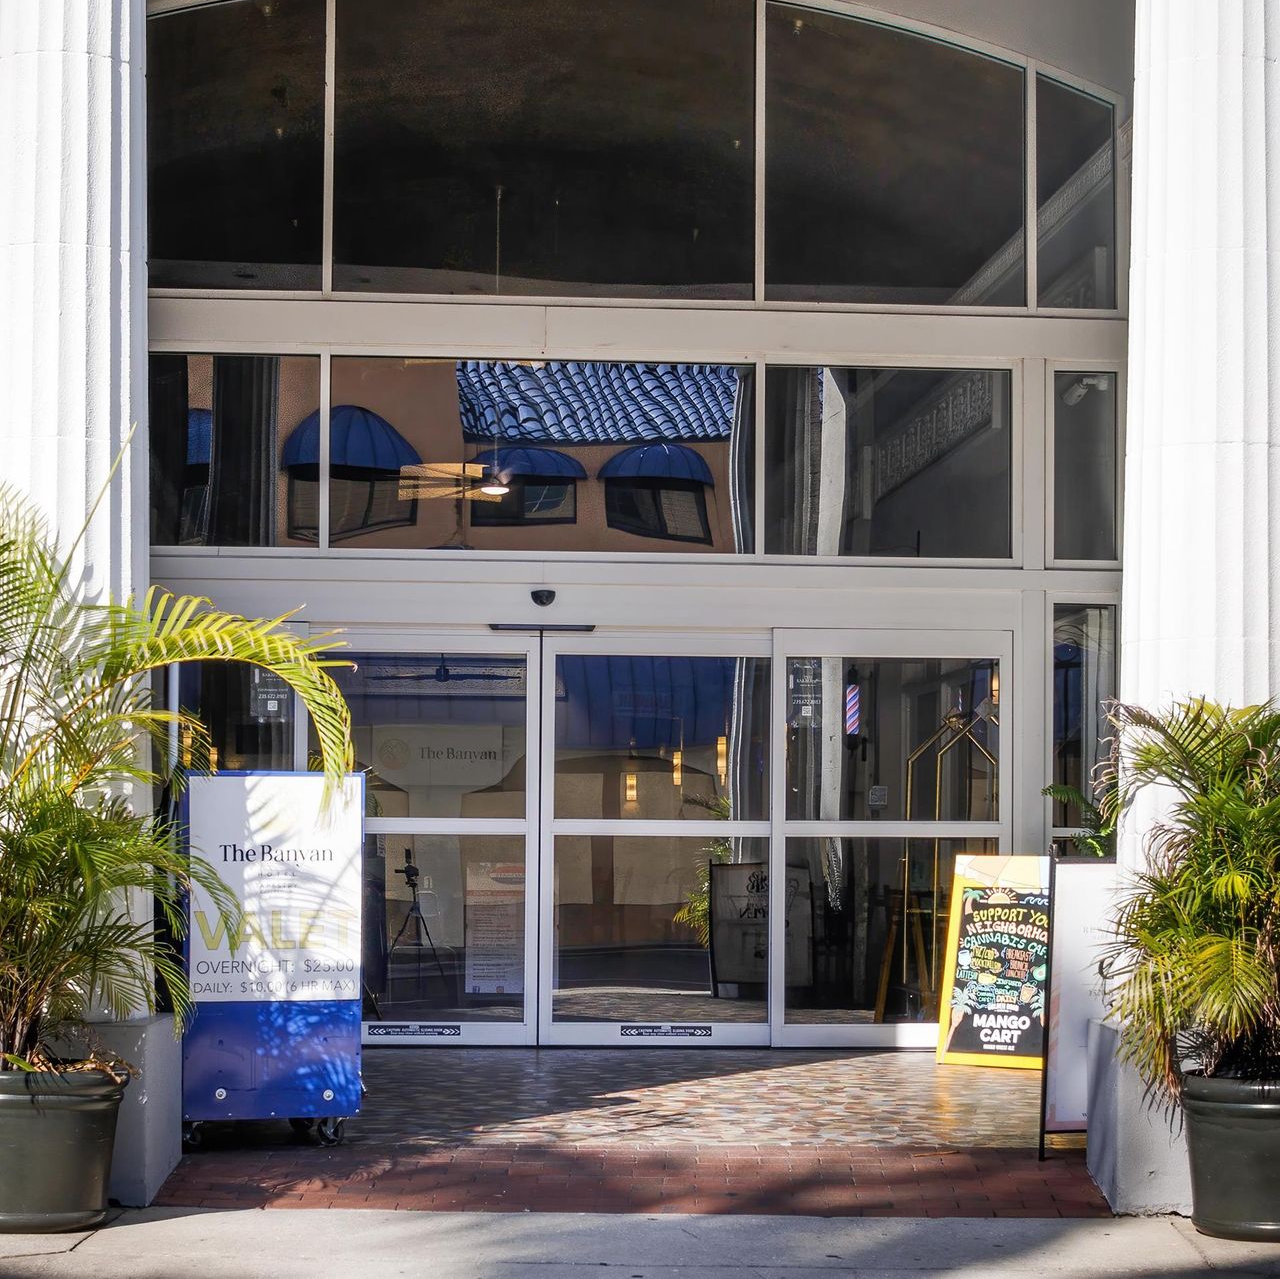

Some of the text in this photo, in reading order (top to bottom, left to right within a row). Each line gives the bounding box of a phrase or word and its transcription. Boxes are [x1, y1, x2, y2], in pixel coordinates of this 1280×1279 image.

[419, 746, 497, 764] The Banyan
[219, 843, 333, 868] The Banyan
[972, 907, 1028, 922] SUPPORT
[193, 910, 357, 950] VALET
[963, 932, 1048, 959] CANNABIS CAF
[196, 958, 354, 975] OVERNIGHT: $25.00
[193, 982, 233, 994] DAILY:
[240, 981, 283, 994] $10.00
[301, 981, 319, 992] HR
[322, 979, 356, 993] MAX)
[972, 1013, 1031, 1030] MANGO
[979, 1028, 1022, 1044] CART
